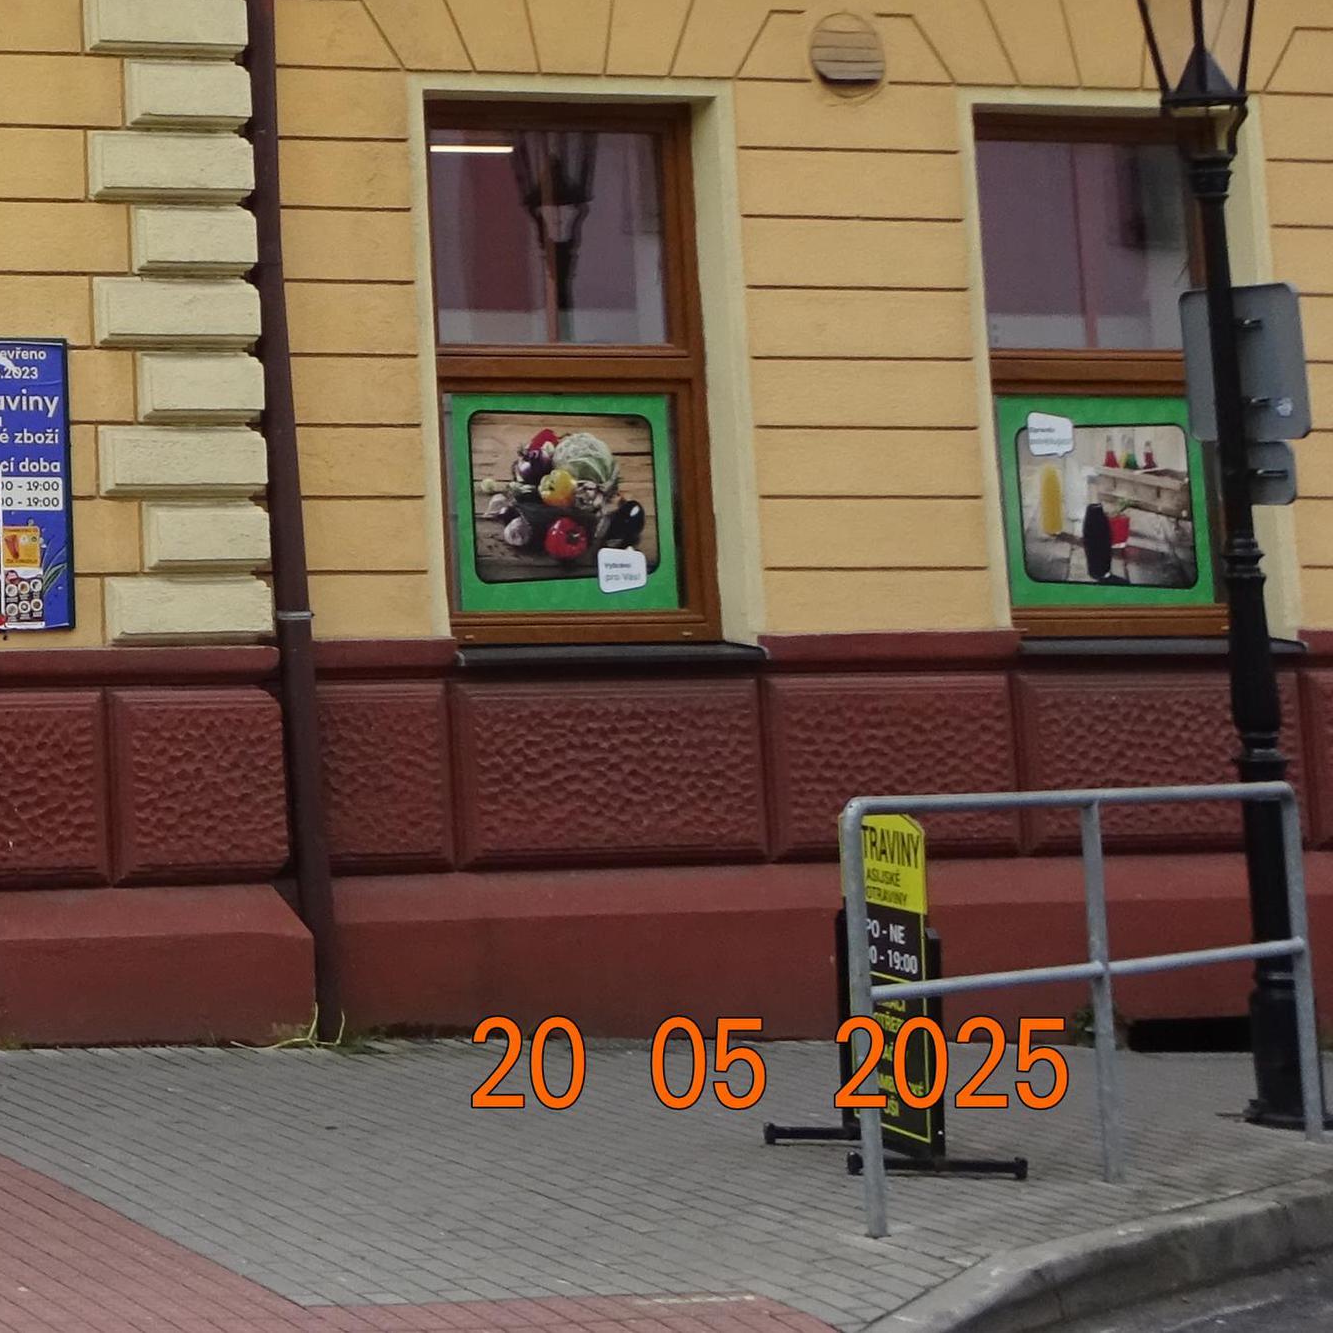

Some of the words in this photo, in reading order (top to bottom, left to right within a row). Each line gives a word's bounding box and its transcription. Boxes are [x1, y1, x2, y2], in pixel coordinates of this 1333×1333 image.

[14, 429, 60, 444] zboží
[19, 458, 60, 473] doba
[26, 481, 60, 492] 19:00
[26, 497, 60, 508] 19:00
[862, 825, 920, 869] TRAVINY
[865, 885, 908, 906] OTRAVINY
[889, 923, 906, 945] NE
[887, 949, 918, 975] 19:00
